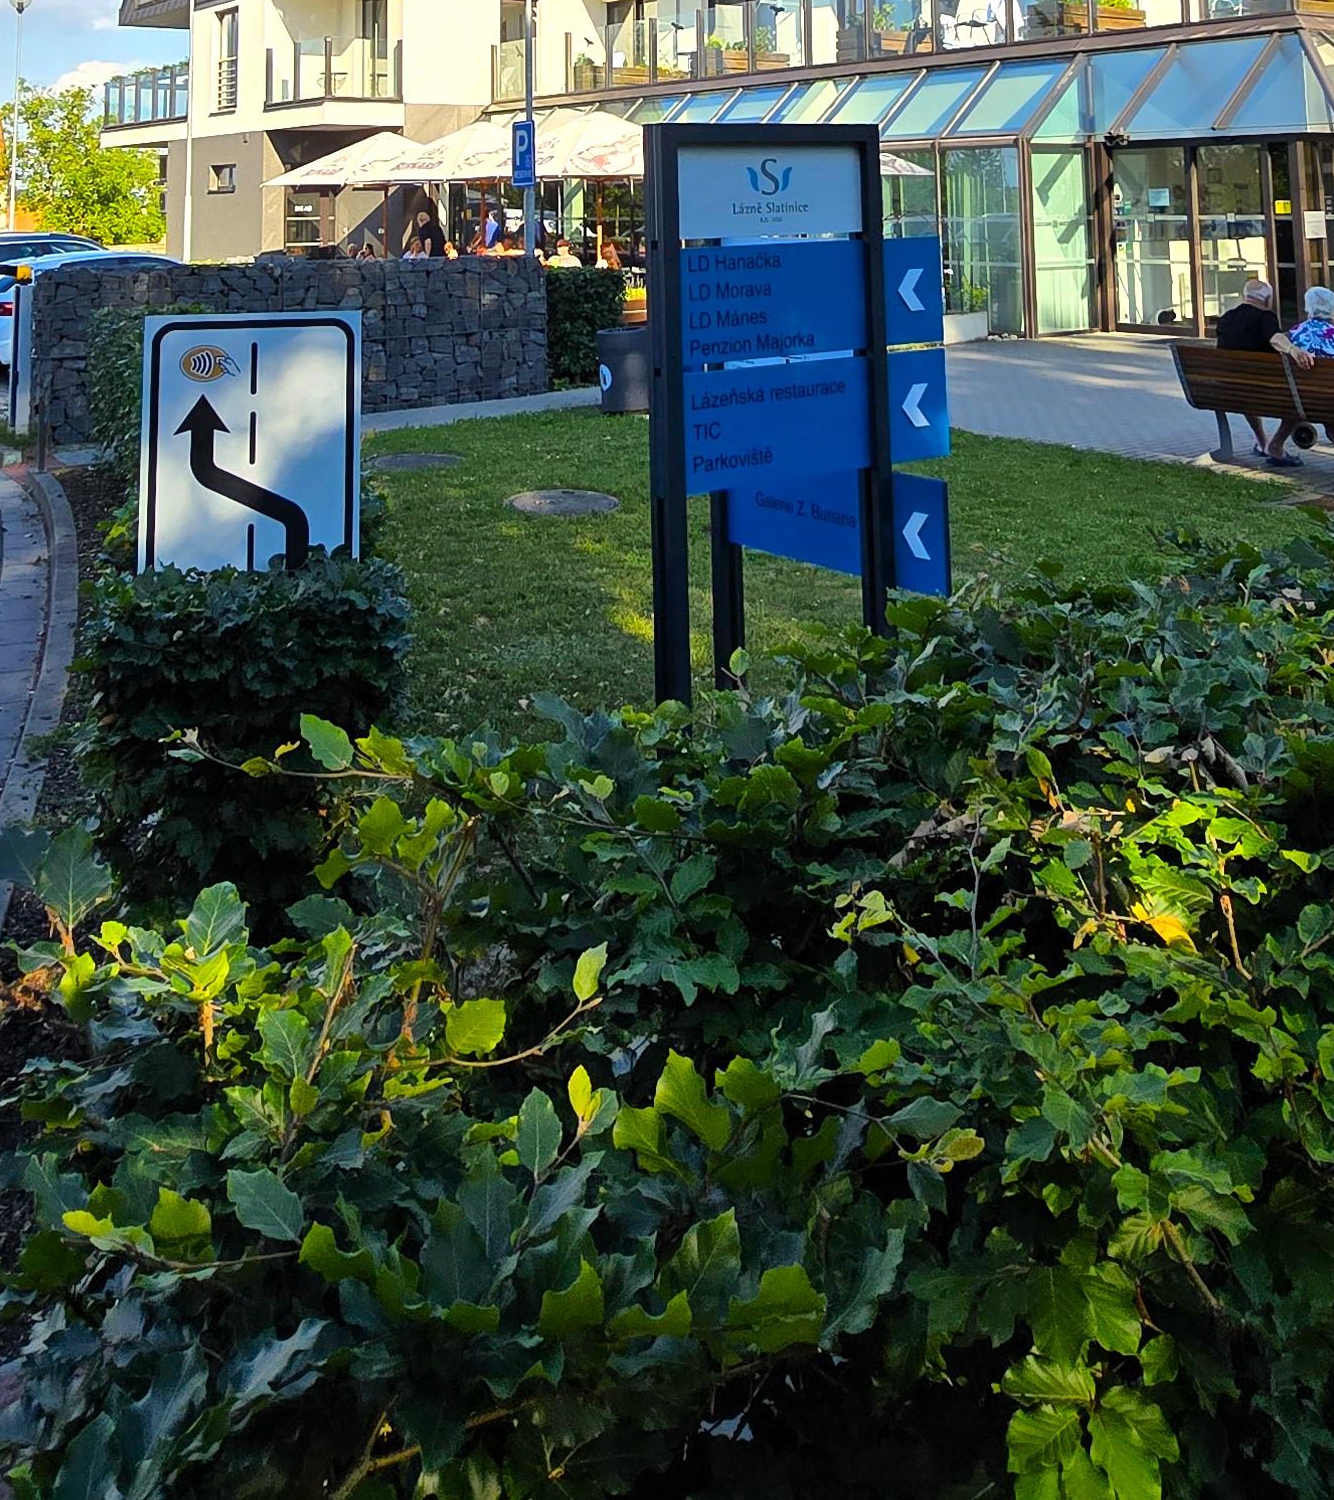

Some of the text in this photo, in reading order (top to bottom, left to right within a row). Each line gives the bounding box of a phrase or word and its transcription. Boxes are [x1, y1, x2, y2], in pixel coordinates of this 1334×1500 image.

[515, 130, 528, 166] P
[732, 201, 809, 215] Lázně Slatinice
[687, 252, 782, 273] LD Hanačka
[688, 281, 772, 301] LD Morava
[689, 309, 768, 330] LD Mánes
[689, 331, 816, 357] Penzion Majorka
[691, 380, 846, 411] Lázeňská restaurace
[692, 421, 722, 442] TIC
[693, 447, 774, 474] Parkoviště
